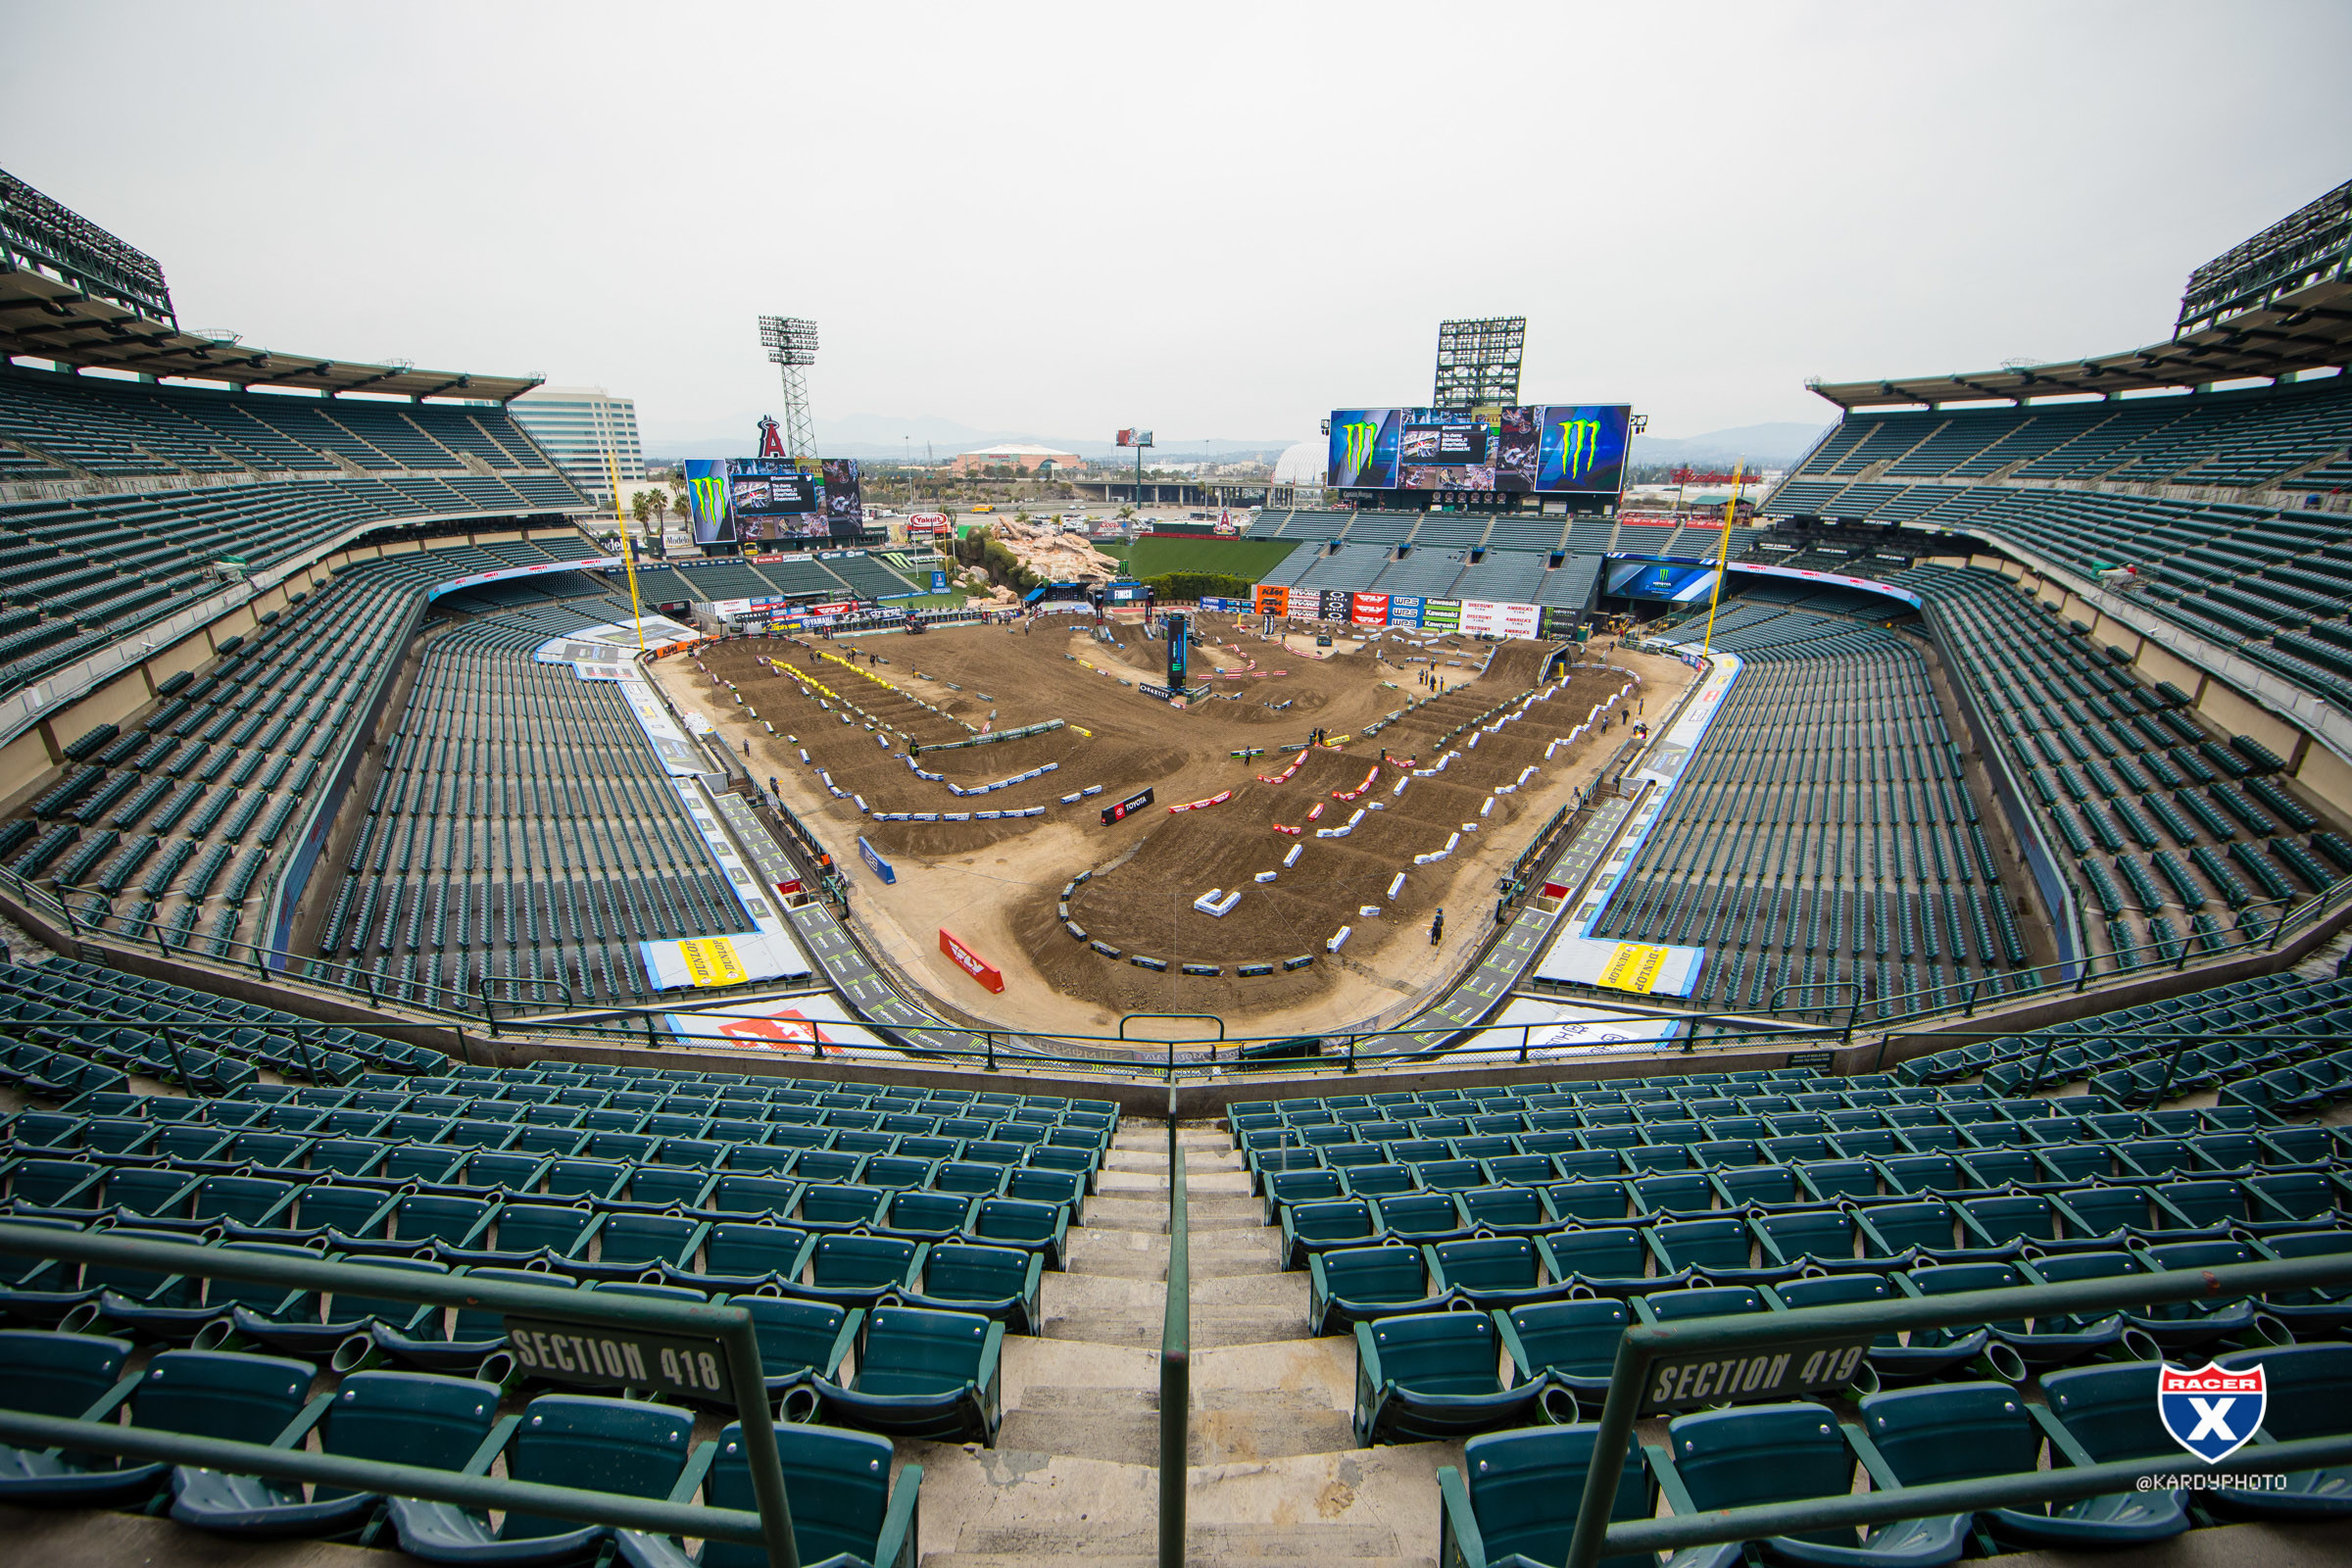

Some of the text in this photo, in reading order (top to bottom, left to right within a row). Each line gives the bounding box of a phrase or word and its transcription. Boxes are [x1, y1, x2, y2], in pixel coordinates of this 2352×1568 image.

[1670, 468, 1762, 483] Budweiser
[667, 536, 690, 545] Modelo
[1114, 590, 1132, 599] FINISH
[1394, 597, 1419, 606] WPS
[1393, 608, 1418, 617] WPS
[808, 615, 835, 626] YAMAHA
[1393, 618, 1417, 628] WPS
[662, 646, 678, 656] KTM
[1147, 686, 1168, 699] OAKLEY
[1125, 796, 1147, 811] TOYOTA
[684, 940, 709, 976] DUNLOP
[712, 940, 735, 970] DUNLOP
[949, 940, 985, 973] FLY
[1608, 952, 1631, 984] DUNLOP
[1635, 953, 1659, 991] DUNLOP
[918, 1033, 943, 1048] MONSTER
[982, 1043, 1010, 1054] MOSTER
[512, 1329, 720, 1391] SECTION 418
[1652, 1346, 1863, 1403] SECTION 419
